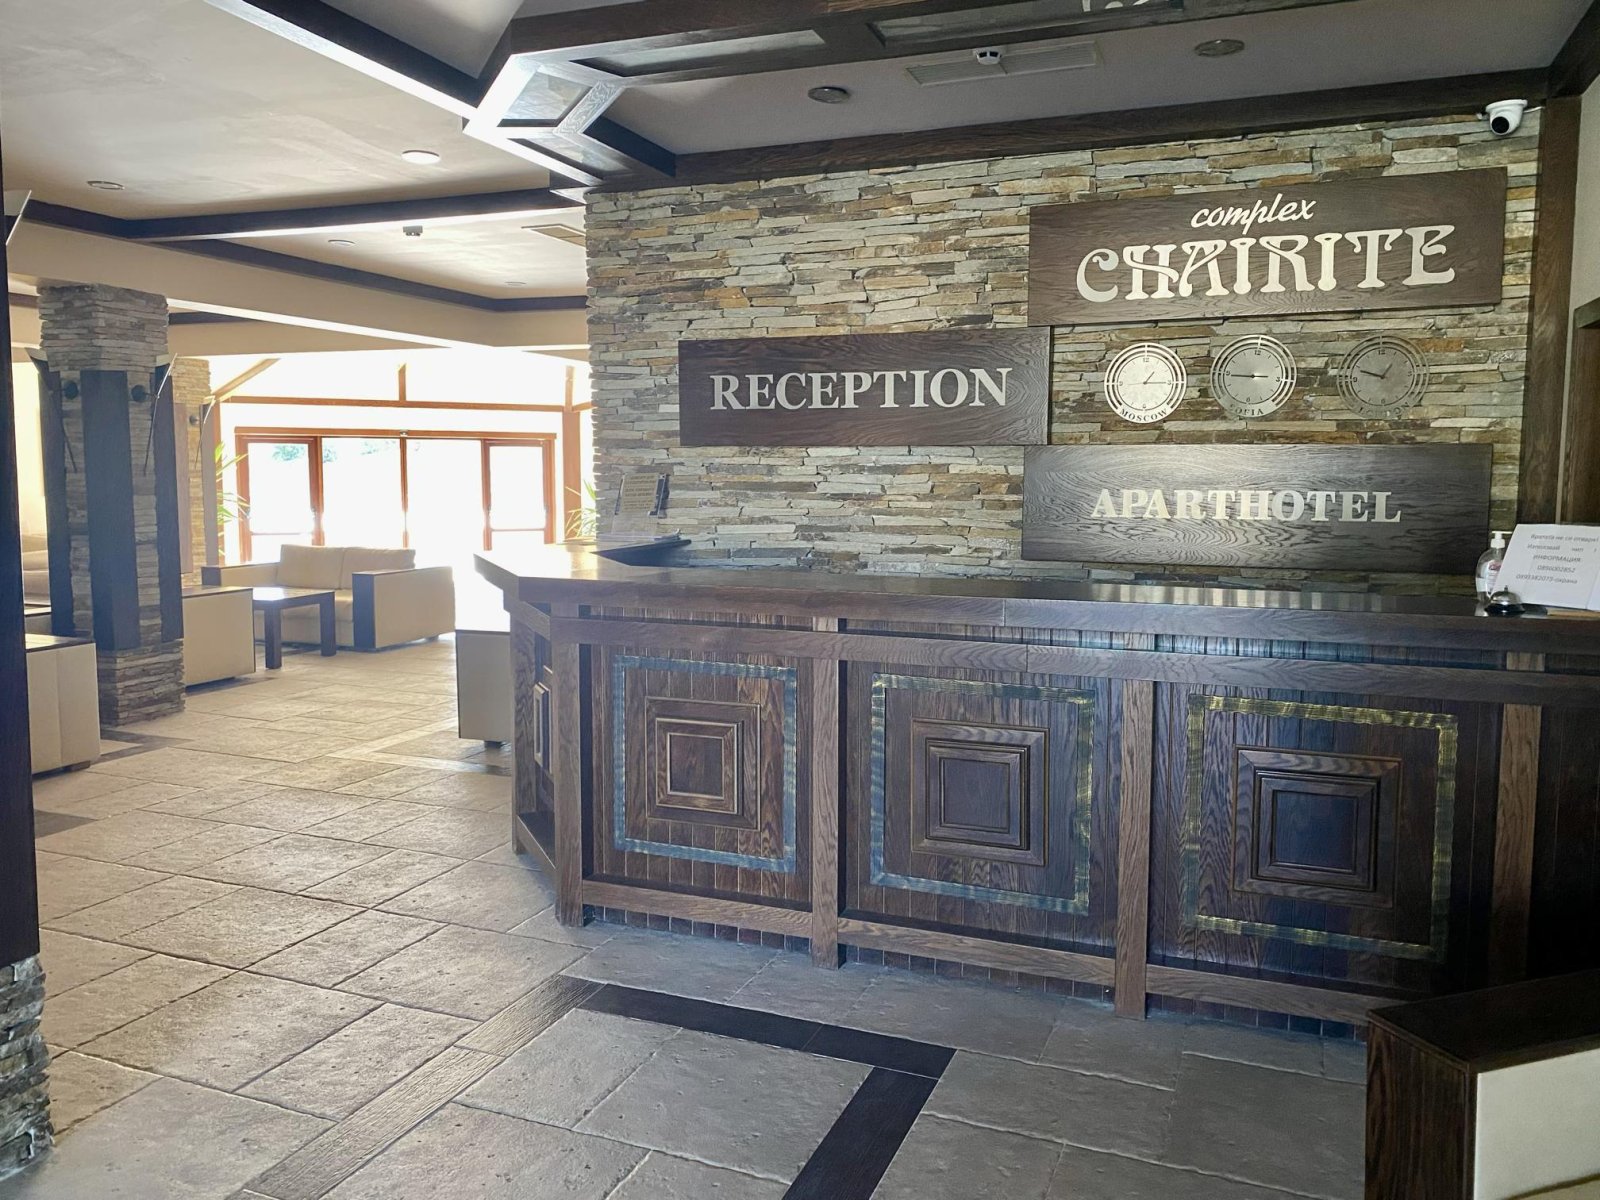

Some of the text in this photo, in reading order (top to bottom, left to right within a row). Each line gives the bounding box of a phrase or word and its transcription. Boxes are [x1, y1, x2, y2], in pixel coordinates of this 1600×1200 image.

[1190, 192, 1317, 235] complex
[1076, 225, 1455, 302] CHAIRITE
[709, 367, 1013, 410] RECEPTION
[1119, 408, 1168, 422] MOSCOW
[1230, 403, 1265, 416] SOFIA
[1090, 488, 1402, 523] APARTHOTEL
[1533, 554, 1581, 563] ИНФОРМАЦИЯ
